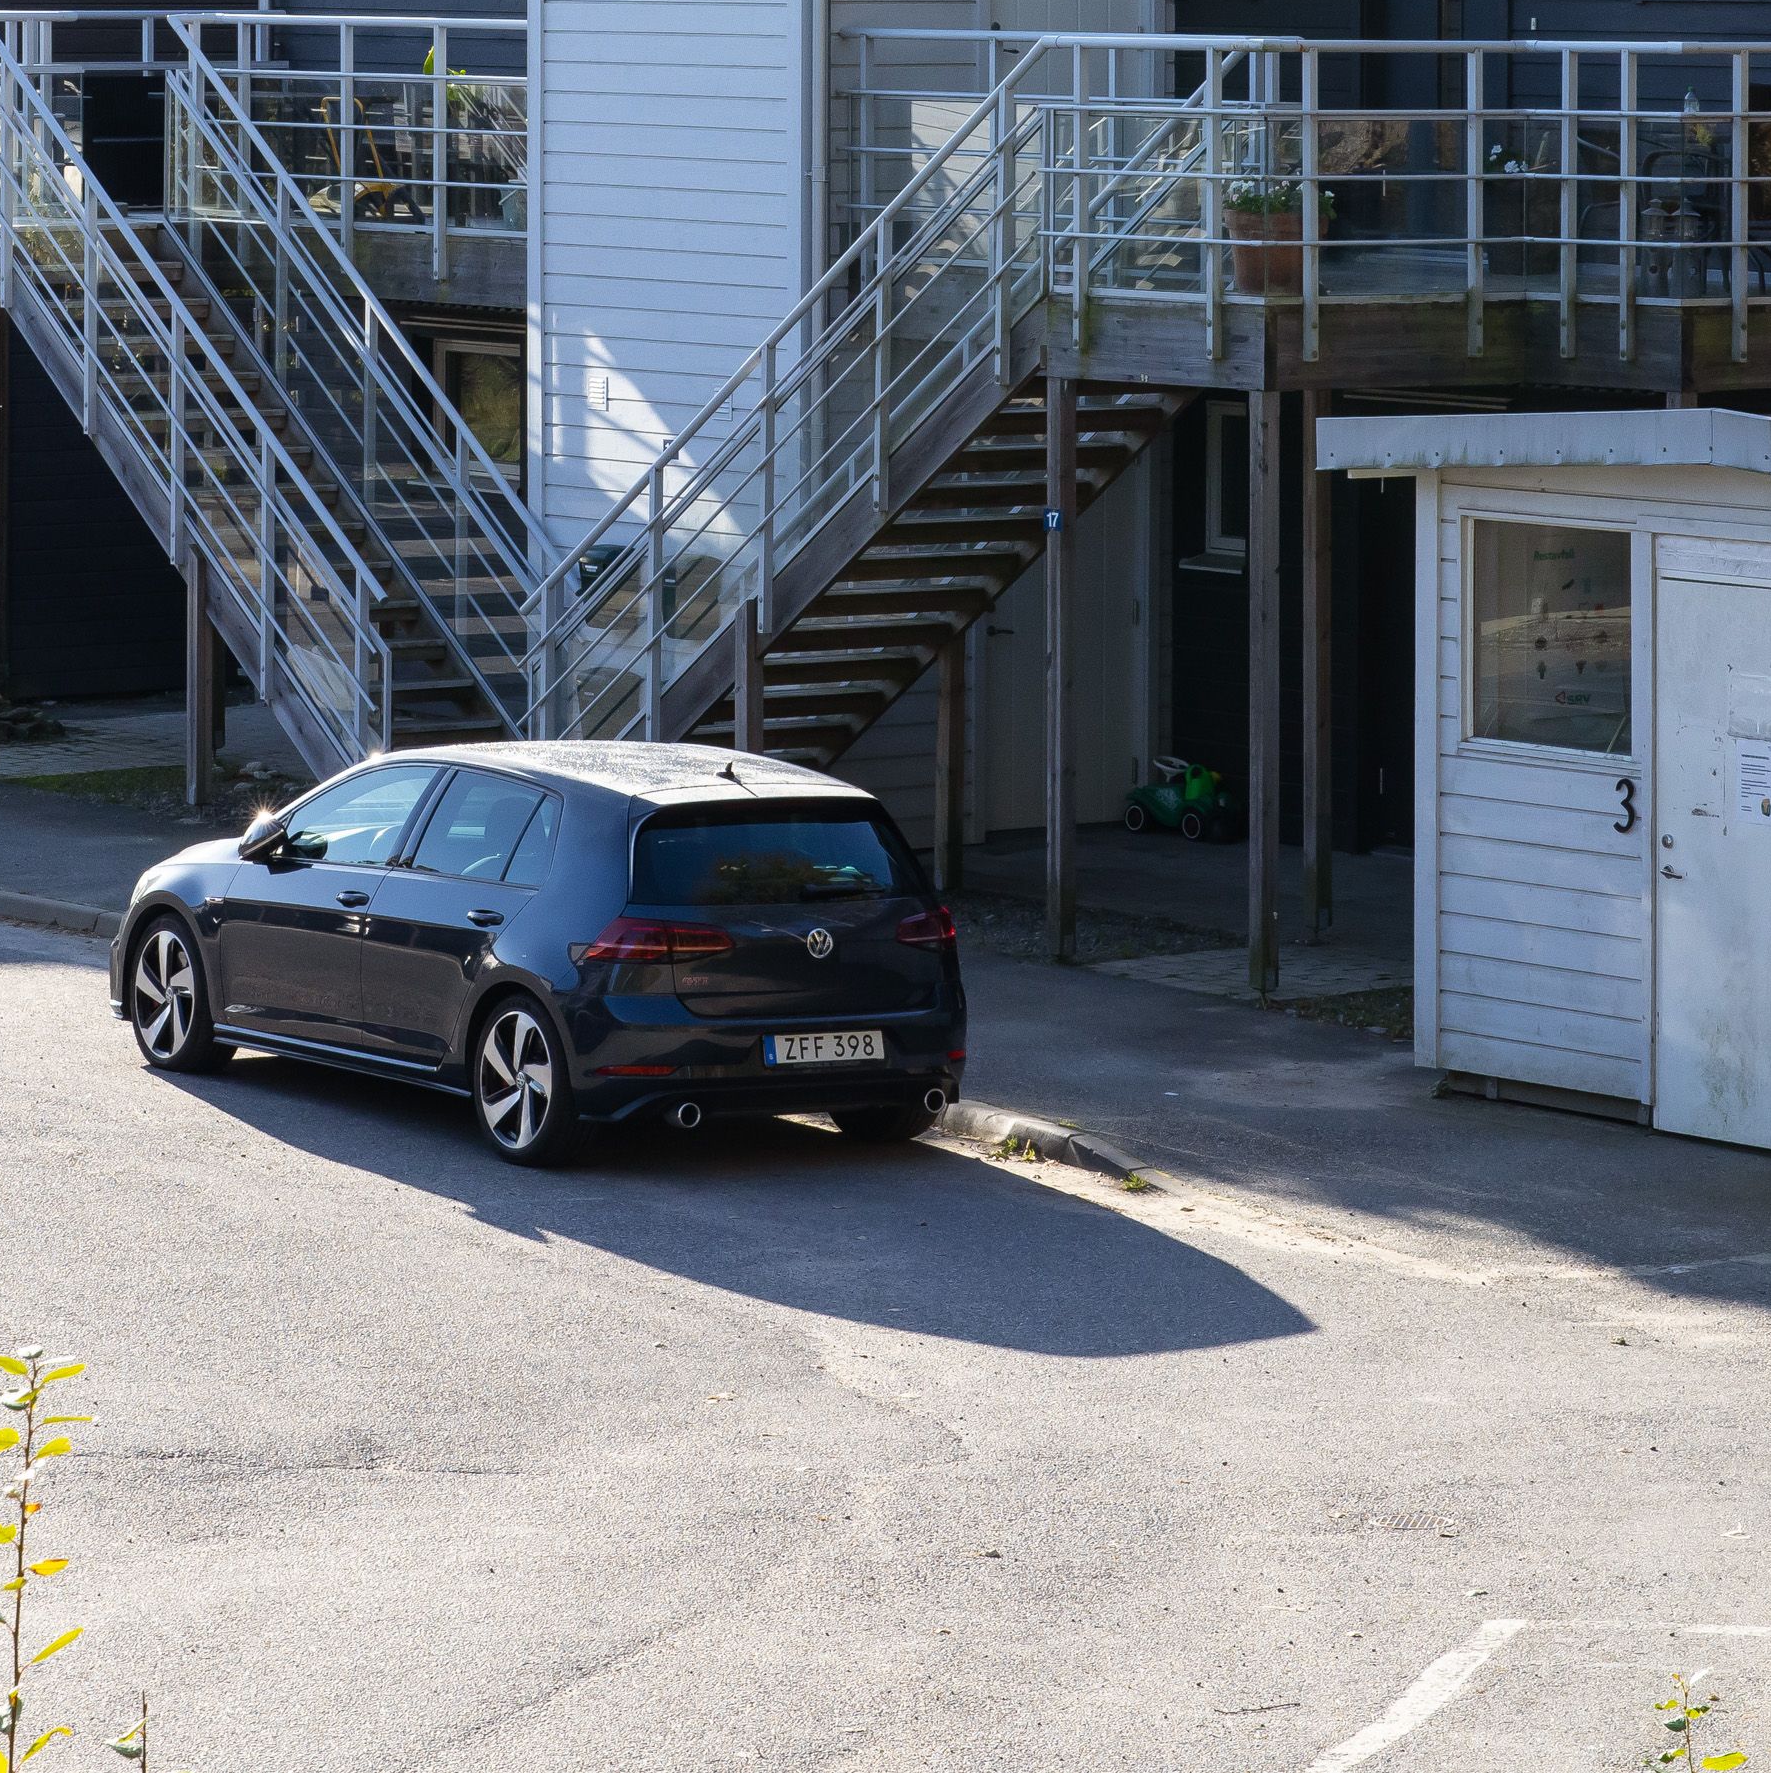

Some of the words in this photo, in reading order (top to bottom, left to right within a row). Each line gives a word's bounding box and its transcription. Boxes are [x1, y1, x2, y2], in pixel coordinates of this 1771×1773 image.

[1047, 512, 1059, 527] 17
[1613, 778, 1635, 833] 3
[784, 1036, 824, 1060] ZFF
[833, 1034, 875, 1057] 398
